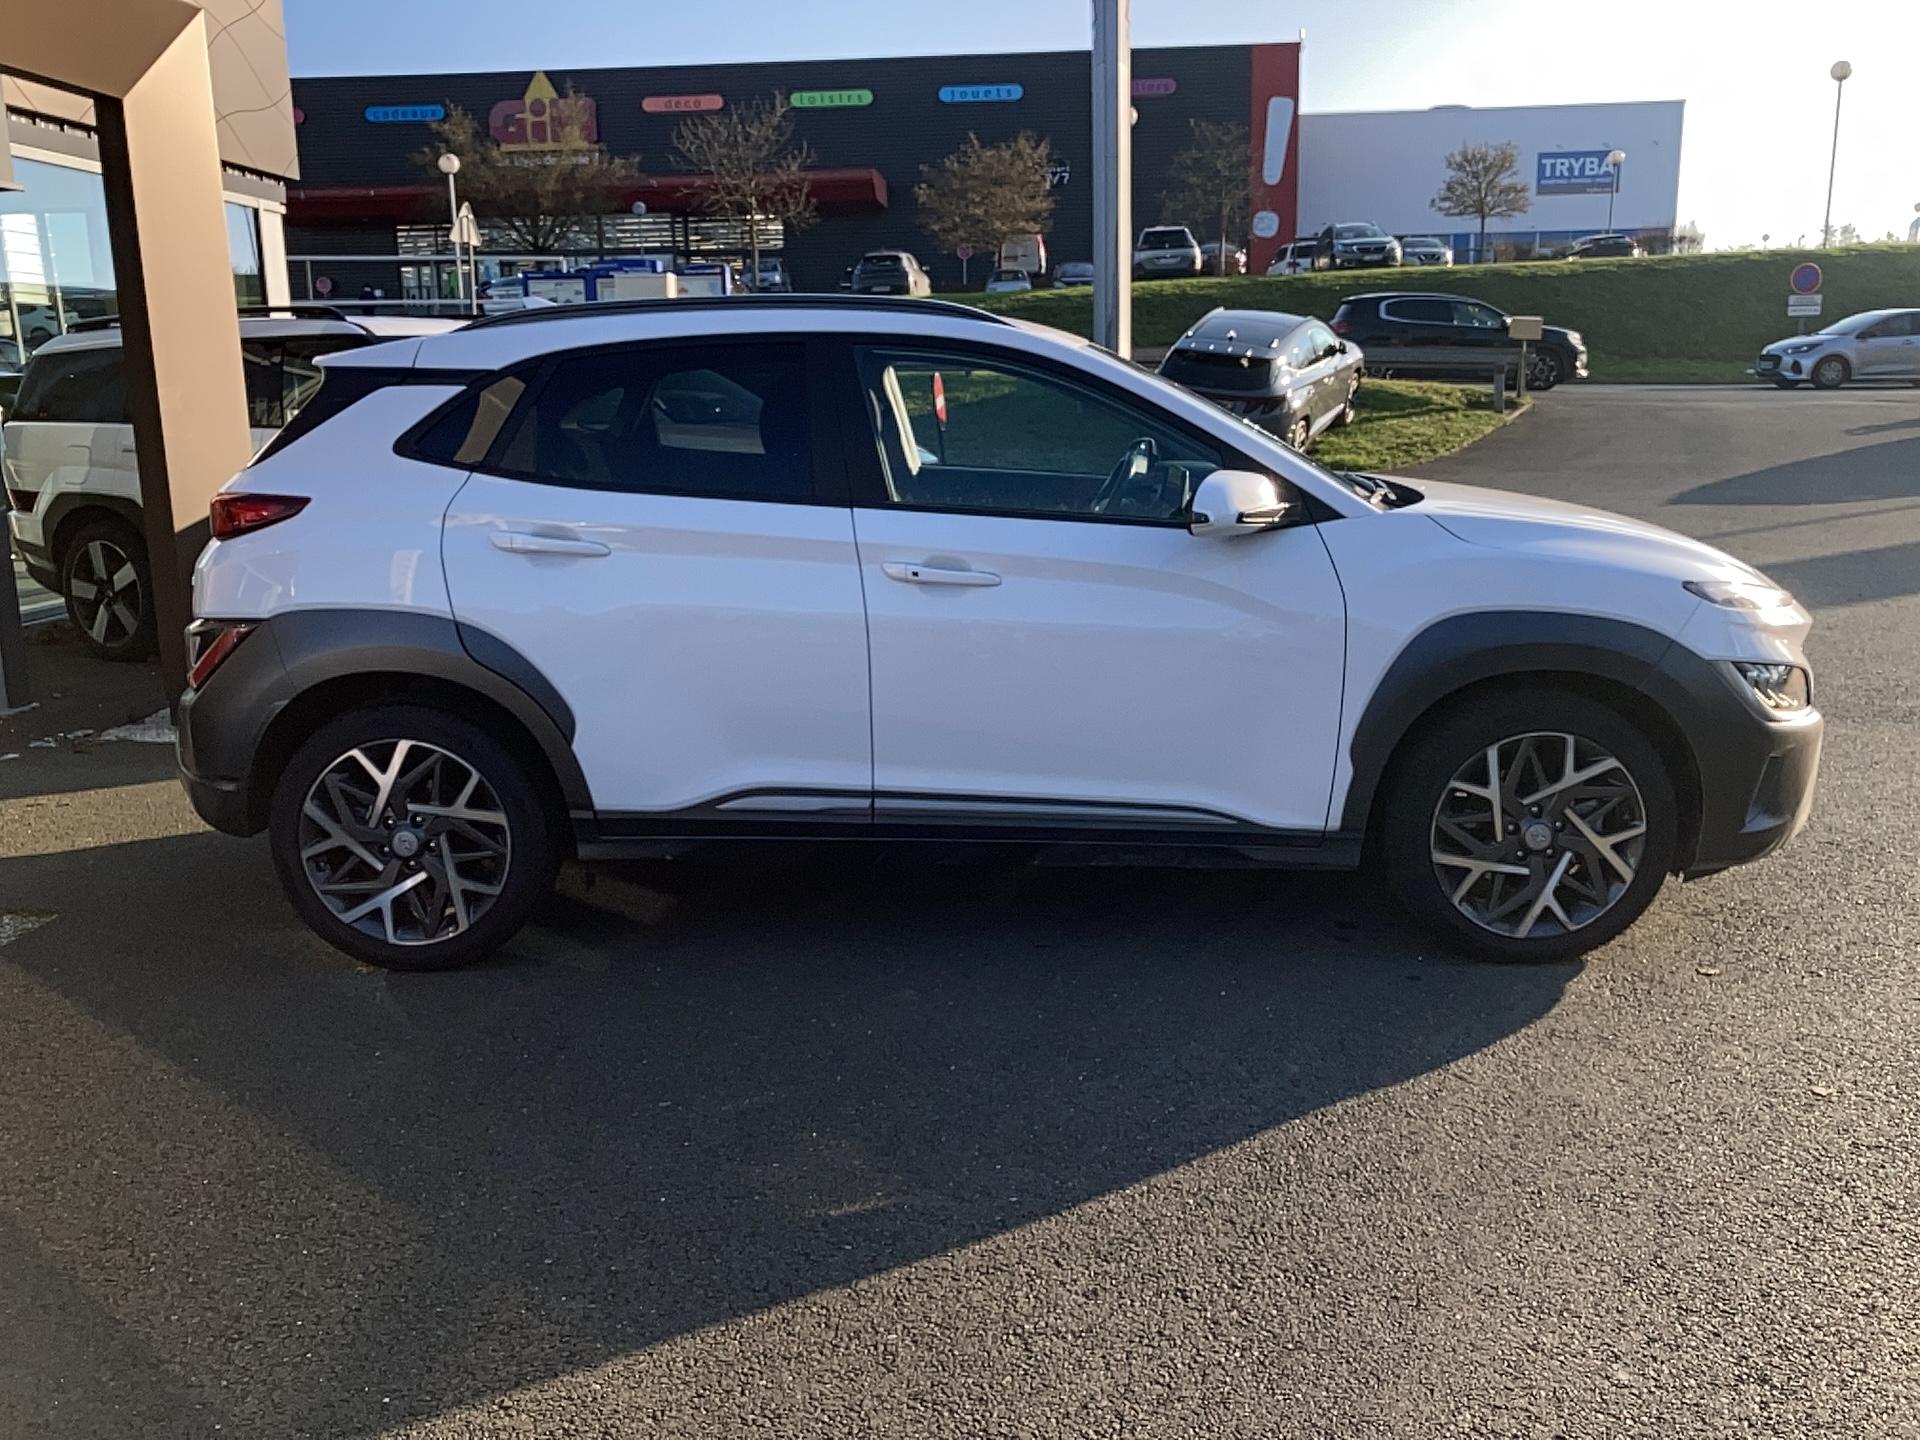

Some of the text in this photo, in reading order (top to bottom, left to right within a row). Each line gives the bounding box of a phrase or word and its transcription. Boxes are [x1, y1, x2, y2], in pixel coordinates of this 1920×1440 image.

[800, 92, 864, 105] loisirs
[950, 87, 1013, 100] jouets
[1541, 157, 1615, 177] TRYBA
